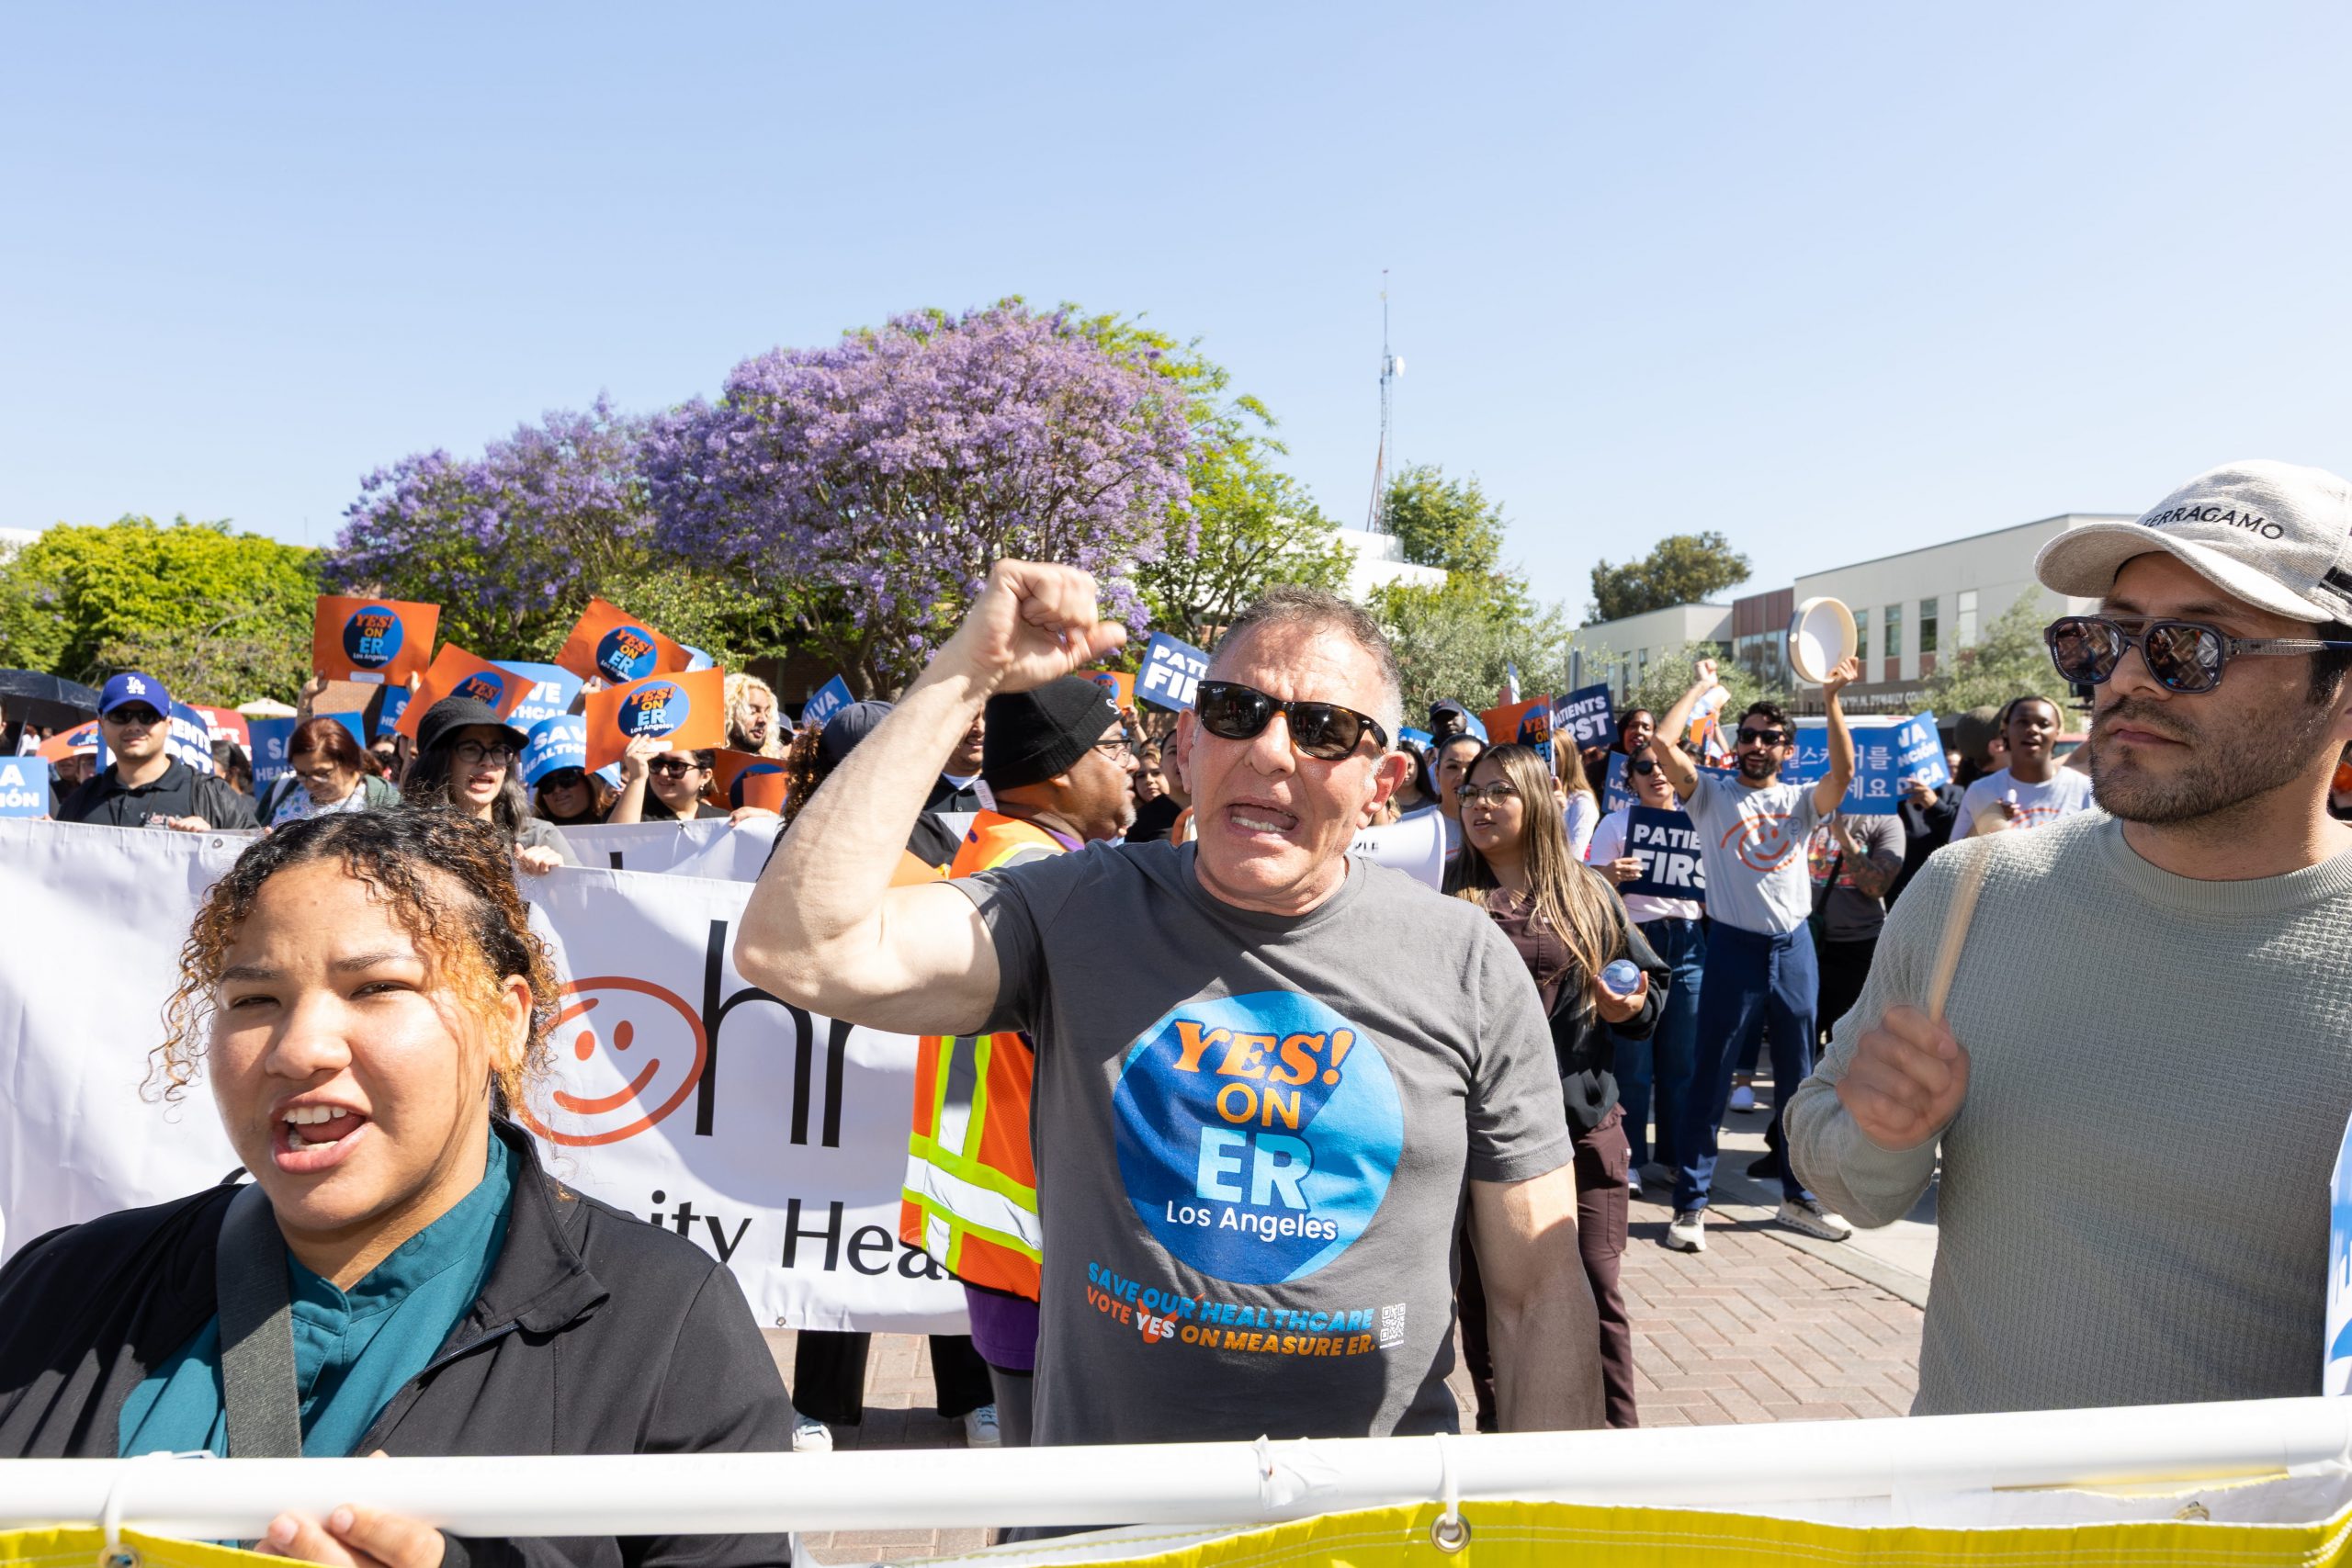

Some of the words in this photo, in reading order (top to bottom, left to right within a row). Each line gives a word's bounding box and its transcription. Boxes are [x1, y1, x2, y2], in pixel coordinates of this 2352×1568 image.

[2143, 505, 2285, 539] FERRAGAMO
[356, 614, 396, 628] YES!
[365, 627, 383, 637] ON
[359, 637, 384, 655] ER
[616, 629, 654, 655] YES!
[619, 644, 639, 660] ON
[608, 649, 635, 673] ER
[127, 676, 145, 695] LA
[467, 677, 503, 700] YES!
[630, 686, 677, 705] YES!
[637, 708, 667, 727] ER
[641, 700, 663, 711] ON
[1554, 695, 1606, 728] ATIENTS
[643, 723, 674, 731] Angeles
[1565, 712, 1610, 743] RST
[1173, 1021, 1353, 1086] YES!
[1216, 1082, 1301, 1130] ON
[1196, 1126, 1312, 1210] ER
[1166, 1201, 1211, 1227] Los
[1219, 1207, 1337, 1242] Angeles
[781, 1198, 959, 1280] Hea
[1088, 1261, 1141, 1303] SAVE
[1142, 1287, 1196, 1319] OUR
[1200, 1301, 1374, 1332] HEALTHCARE
[1087, 1285, 1133, 1325] VOTE
[1136, 1311, 1176, 1338] YES
[1181, 1325, 1220, 1348] ON
[1223, 1331, 1344, 1357] MEASURE
[1346, 1334, 1376, 1356] ER.
